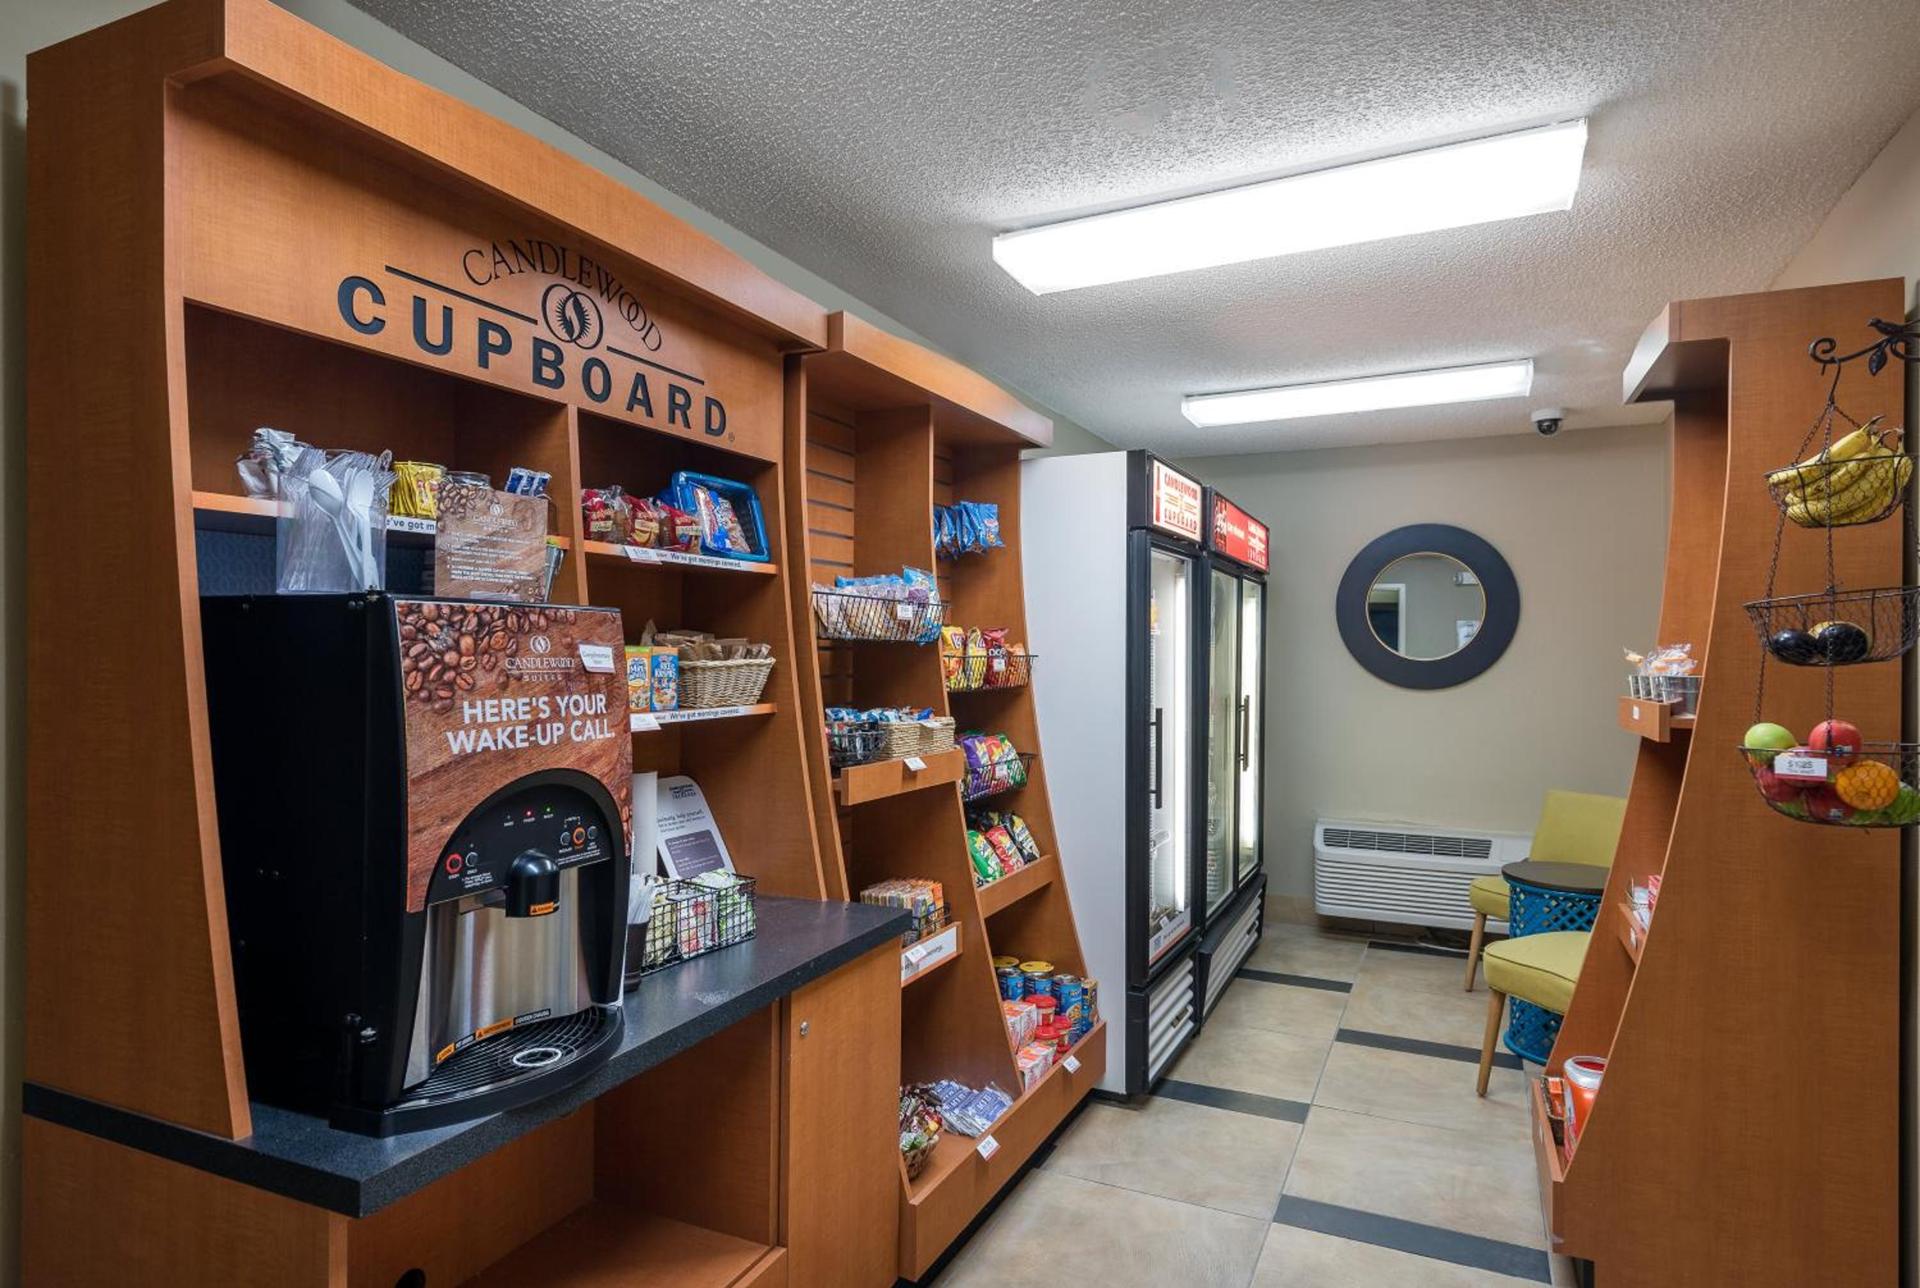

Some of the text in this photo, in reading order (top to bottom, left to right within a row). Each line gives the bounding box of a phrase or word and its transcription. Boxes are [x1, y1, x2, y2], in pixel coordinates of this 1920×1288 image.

[463, 239, 663, 352] CANDLEWOOD
[337, 275, 729, 438] CUPBOARD
[407, 521, 424, 531] got
[505, 657, 576, 670] CANDLEWOOD
[523, 673, 563, 682] SUITES
[462, 694, 607, 724] HERE'S YOUR
[446, 722, 566, 755] WAKE-UP
[570, 718, 616, 743] CALL.
